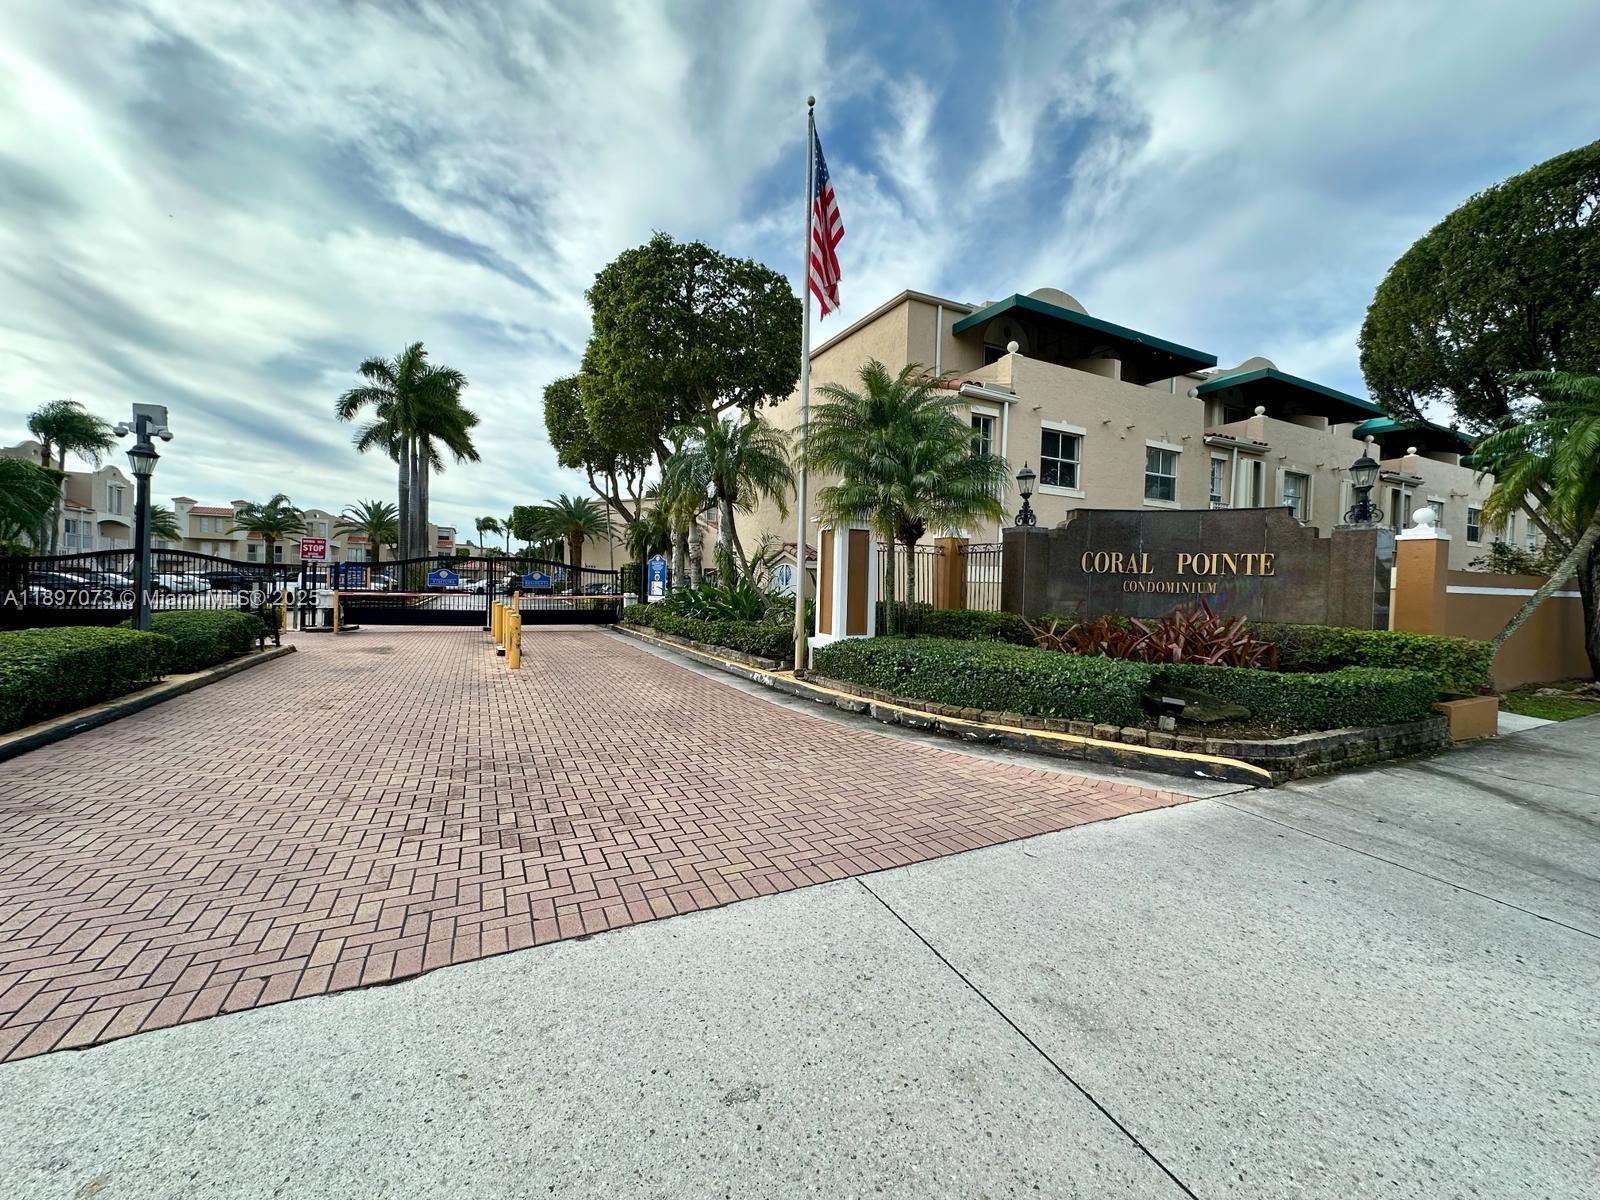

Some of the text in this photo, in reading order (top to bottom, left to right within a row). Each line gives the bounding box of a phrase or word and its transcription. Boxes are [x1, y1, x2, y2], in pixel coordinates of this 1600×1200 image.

[303, 544, 324, 552] STOP
[1081, 551, 1275, 576] CORAL POINTE
[1123, 580, 1217, 594] CONDOMINIUM
